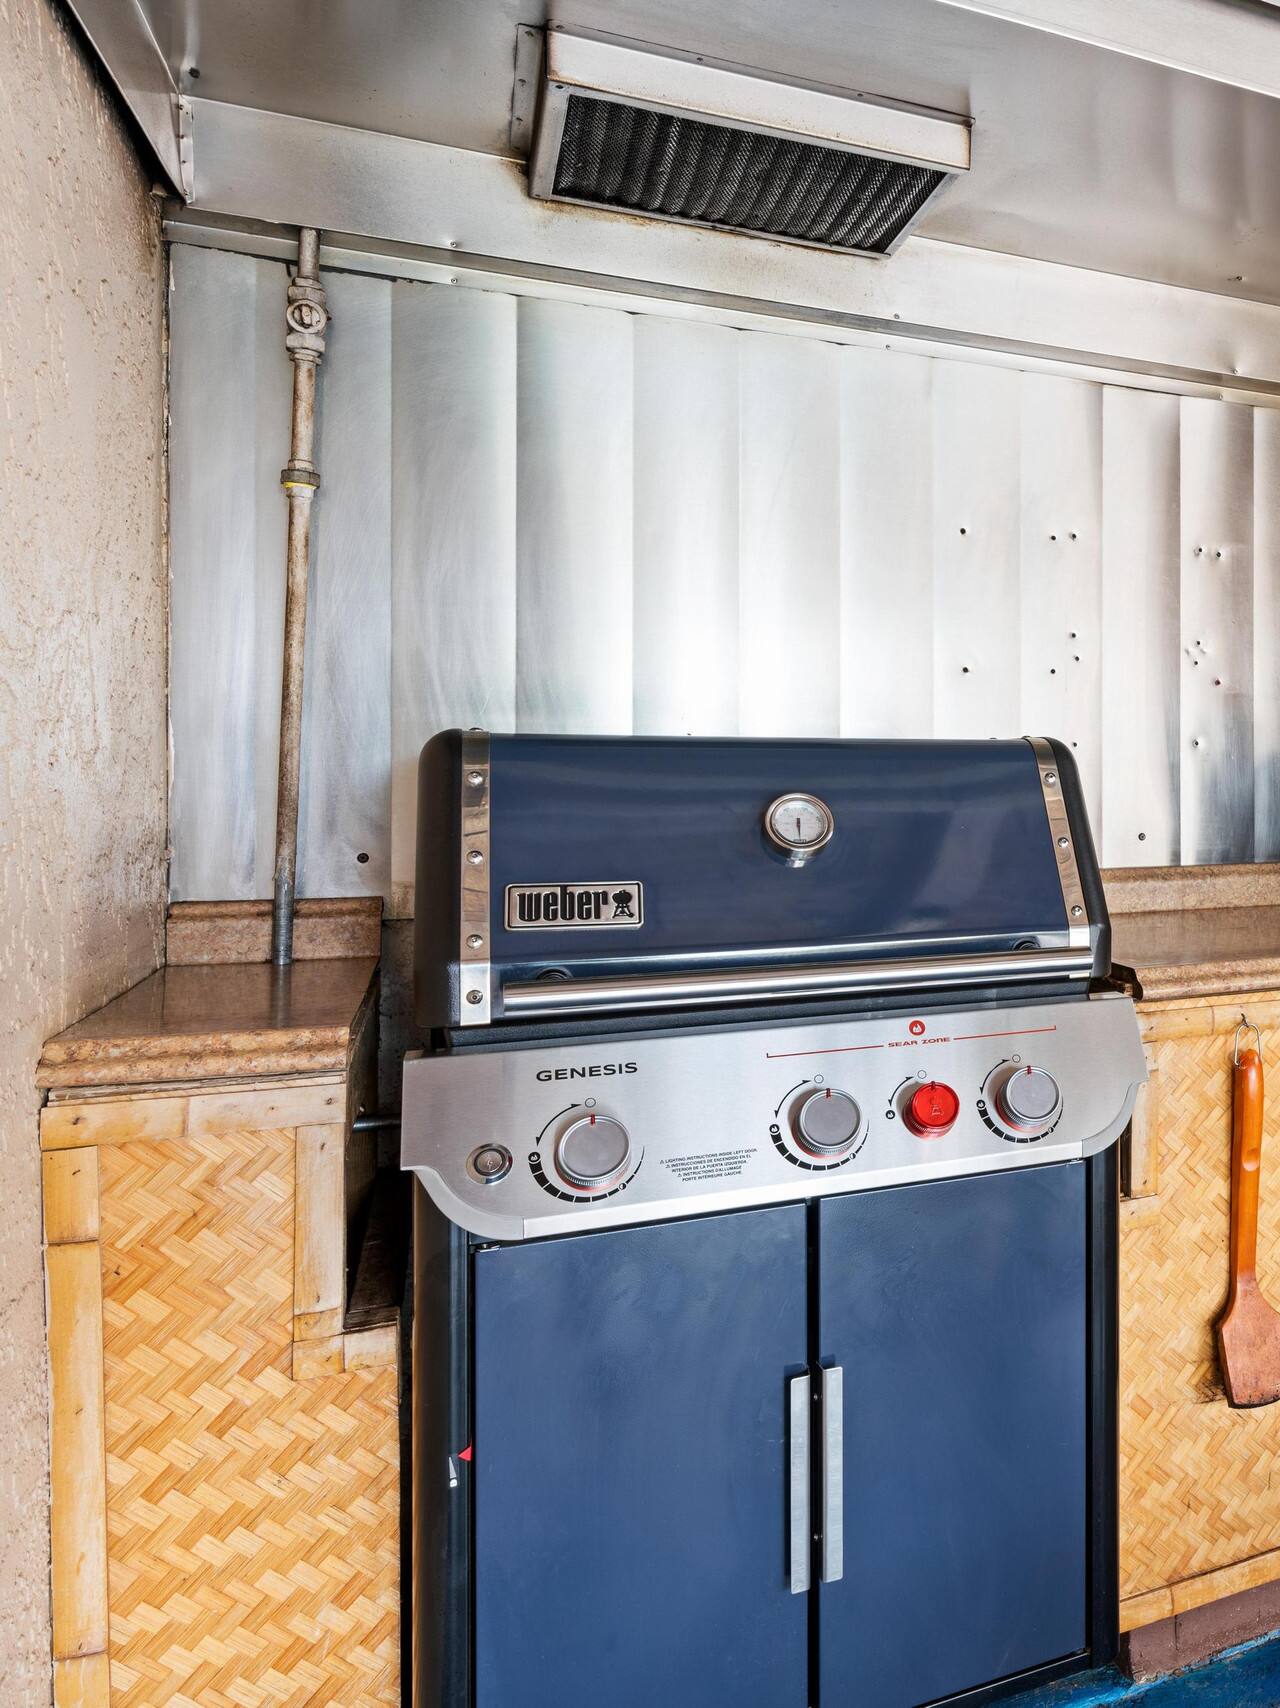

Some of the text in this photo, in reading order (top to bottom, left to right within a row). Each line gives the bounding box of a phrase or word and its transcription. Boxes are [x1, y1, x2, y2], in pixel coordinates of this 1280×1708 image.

[517, 886, 608, 921] weber
[888, 1040, 918, 1048] SEAR
[536, 1062, 638, 1082] GENESIS
[686, 1153, 718, 1161] INSTRUCTIONS
[671, 1160, 706, 1168] INSTRUCCIONES
[683, 1169, 714, 1177] INSTRUCTIONS
